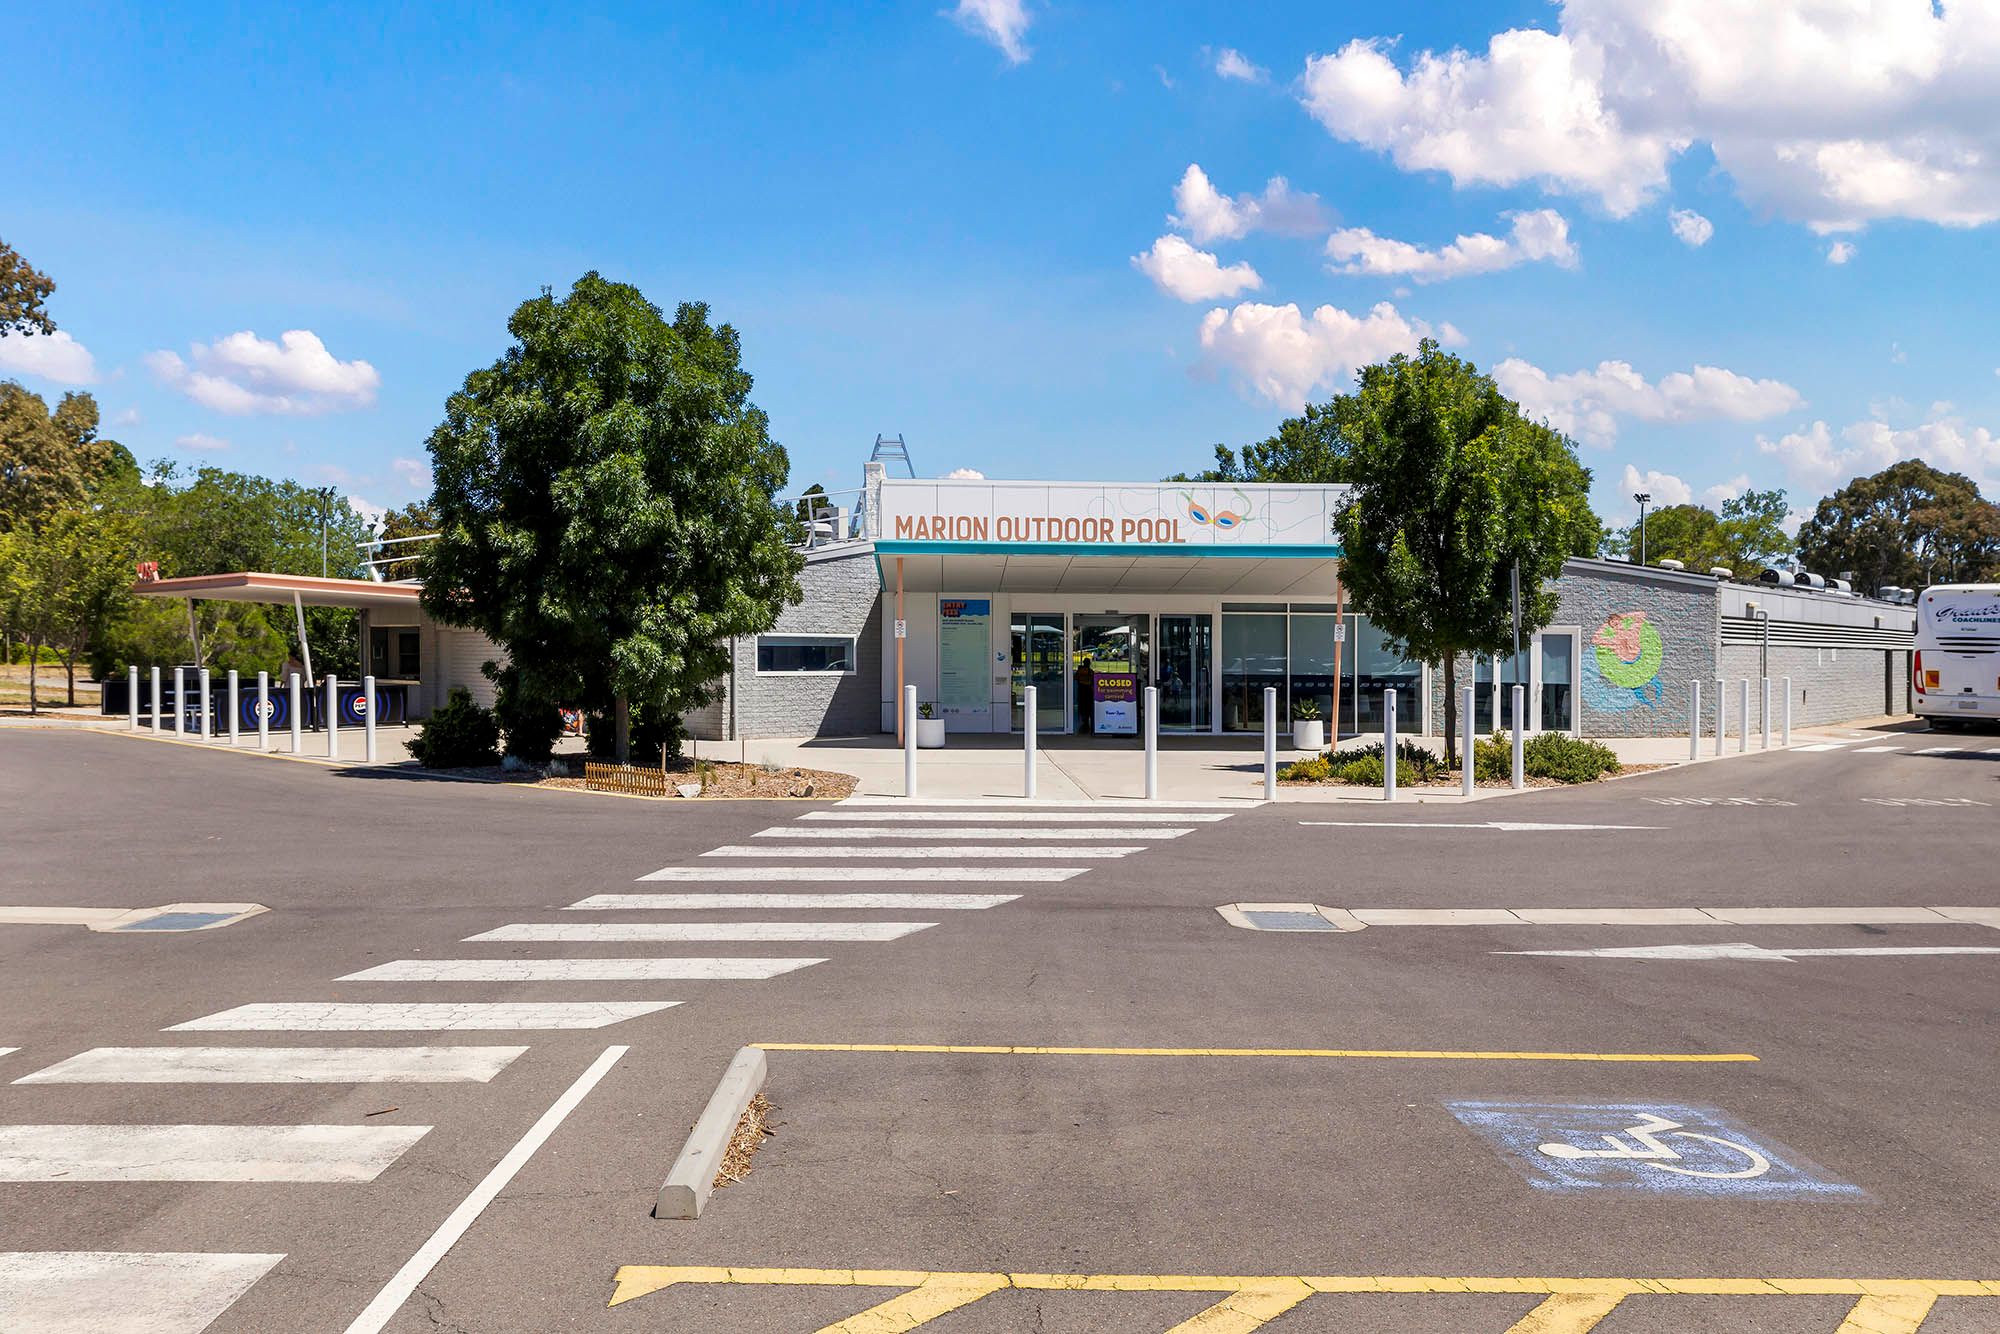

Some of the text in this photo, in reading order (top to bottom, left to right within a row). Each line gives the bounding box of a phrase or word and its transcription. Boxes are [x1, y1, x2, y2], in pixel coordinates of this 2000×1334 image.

[895, 515, 1186, 543] MARION OUTDOOR POOL
[1098, 679, 1132, 687] CLOSED
